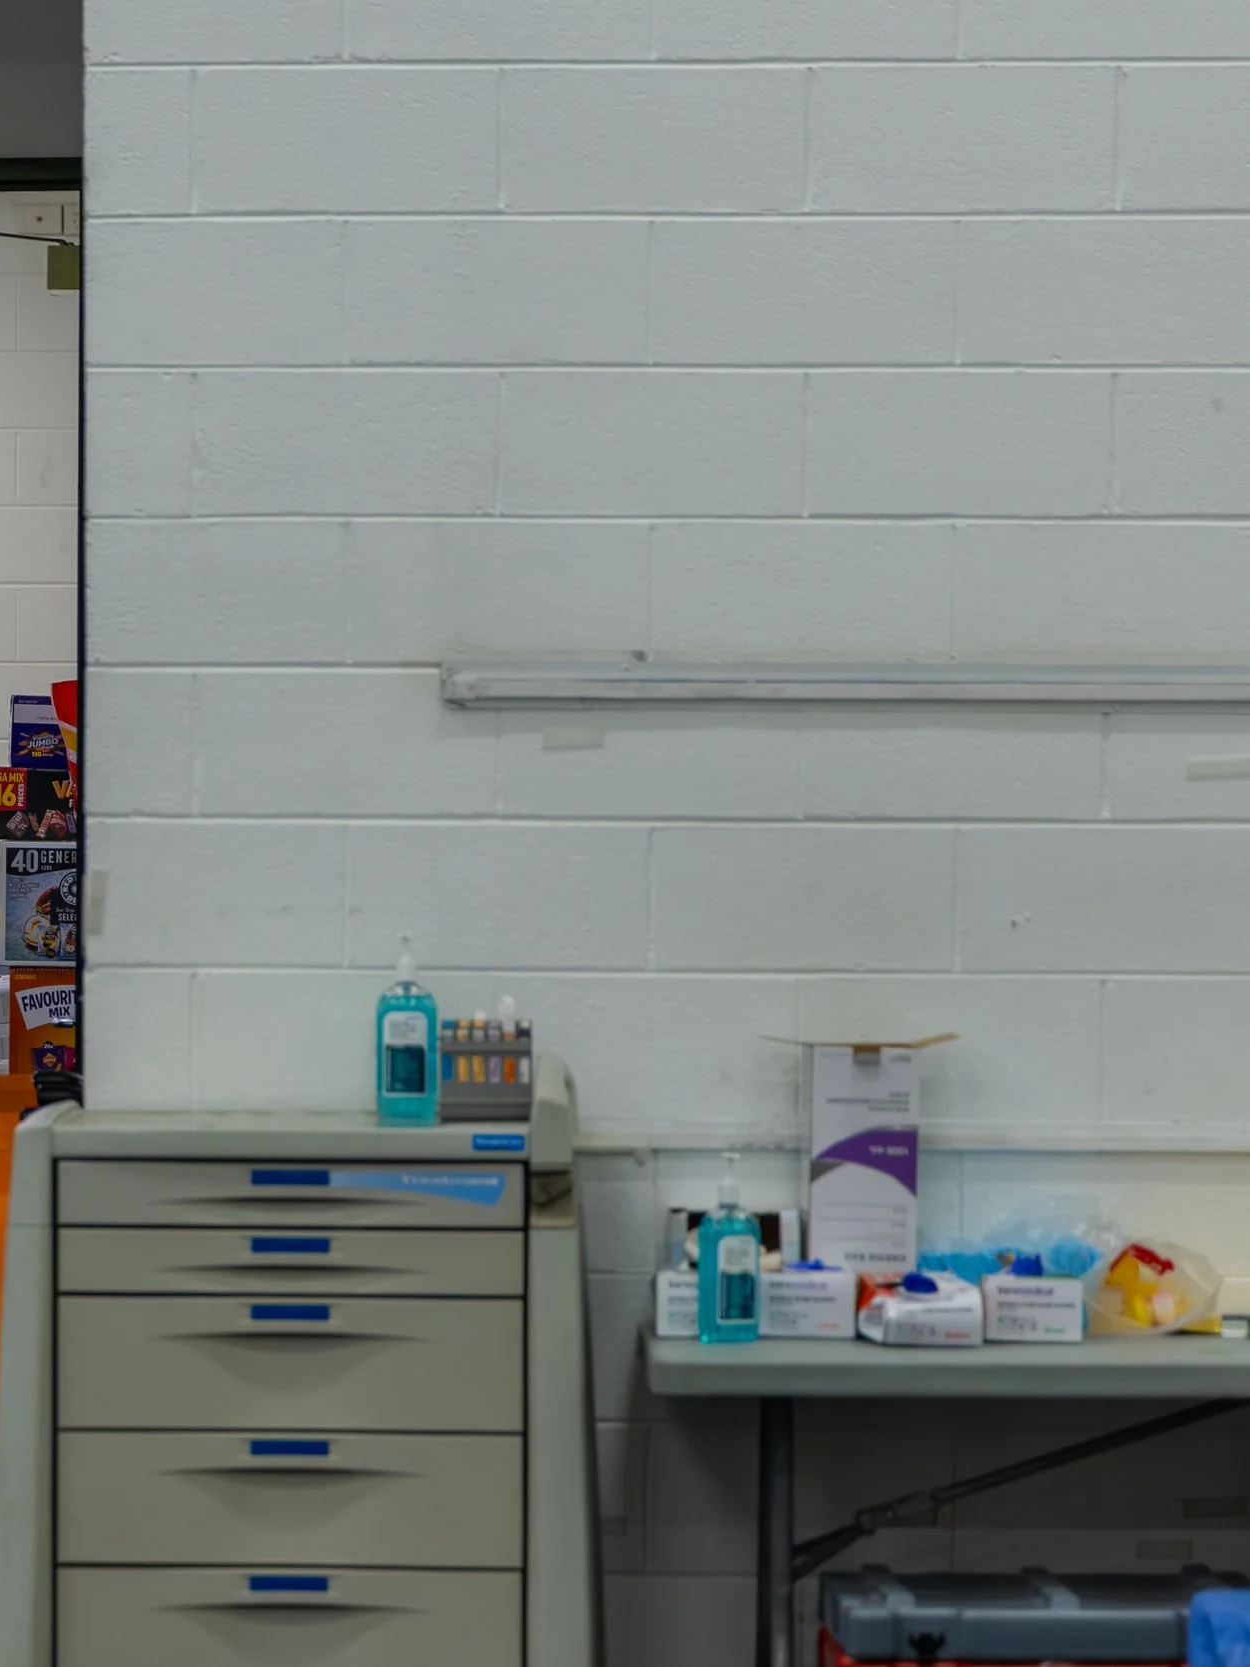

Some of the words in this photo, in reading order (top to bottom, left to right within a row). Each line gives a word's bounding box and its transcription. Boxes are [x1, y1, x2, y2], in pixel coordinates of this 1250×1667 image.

[27, 738, 59, 748] JUMBO
[9, 772, 24, 782] MIX
[10, 849, 39, 873] 40
[62, 876, 74, 892] RED
[58, 913, 77, 922] SELE
[48, 1006, 70, 1018] MIX
